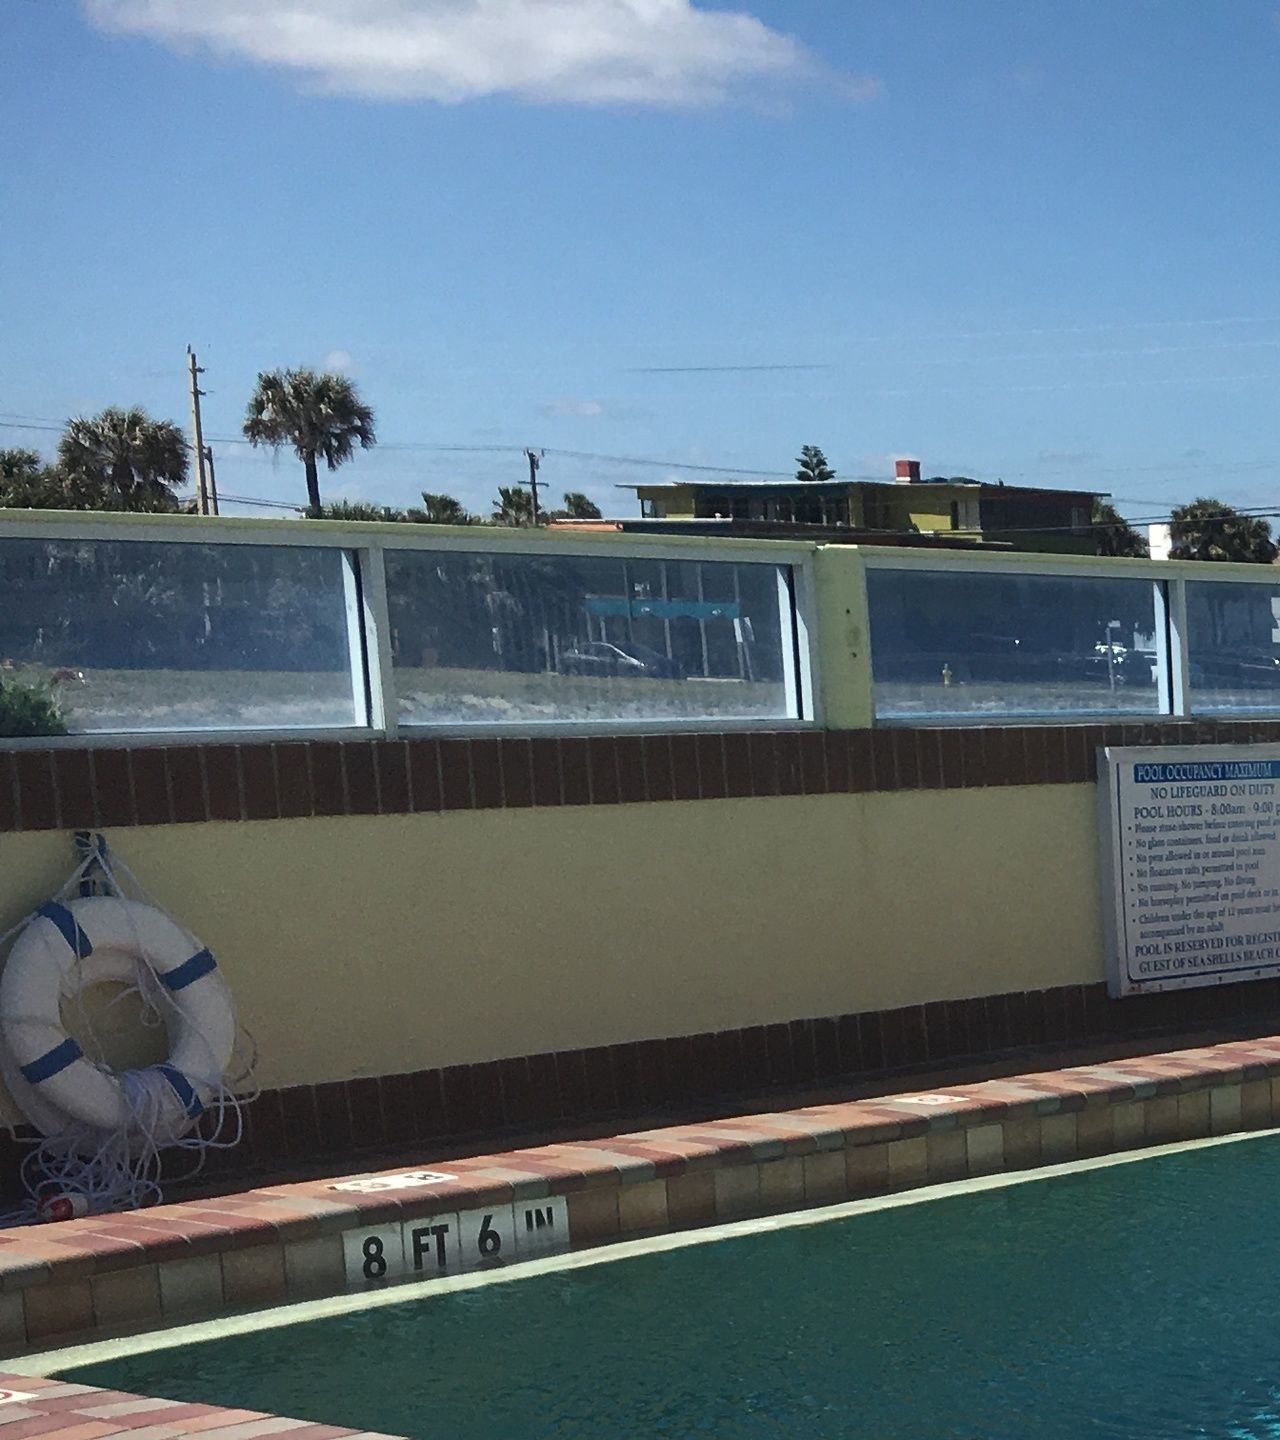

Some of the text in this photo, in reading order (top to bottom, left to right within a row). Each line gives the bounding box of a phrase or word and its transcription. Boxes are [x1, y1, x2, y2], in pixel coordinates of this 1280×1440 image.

[1137, 763, 1272, 781] POOL OCCUPANCY MAXIMUM
[1151, 784, 1275, 800] NO LIFEGUARD ON DUTY
[1135, 806, 1164, 819] POOL
[1167, 805, 1203, 817] HOURS
[1135, 823, 1156, 833] Please
[1257, 817, 1271, 830] pool
[1136, 839, 1147, 848] No
[1148, 837, 1166, 850] glass
[1206, 833, 1221, 844] food
[1137, 854, 1147, 863] No
[1166, 850, 1192, 862] allowed
[1202, 851, 1210, 859] or
[1236, 847, 1251, 859] pool
[1137, 869, 1147, 878] No
[1202, 862, 1234, 876] permitted
[1236, 862, 1243, 870] in
[1245, 860, 1259, 873] pool
[1138, 884, 1148, 892] No
[1181, 880, 1192, 889] No
[1224, 877, 1234, 886] No
[1138, 898, 1149, 907] No
[1186, 892, 1219, 907] permitted
[1231, 889, 1245, 902] pool
[1139, 913, 1170, 924] Children
[1171, 910, 1191, 922] under
[1193, 909, 1204, 920] the
[1206, 911, 1218, 921] age
[1218, 907, 1226, 917] of
[1228, 906, 1235, 916] 12
[1186, 924, 1195, 936] by
[1197, 926, 1205, 934] an
[1207, 922, 1224, 933] adult
[1136, 944, 1162, 958] POOL
[1164, 942, 1173, 954] IS
[1175, 938, 1224, 953] RESERVED
[1226, 935, 1244, 948] FOR
[1139, 959, 1171, 973] GUEST
[1173, 957, 1186, 969] OF
[1243, 948, 1274, 961] BEACH
[363, 1207, 554, 1279] 8 FT 6 IN
